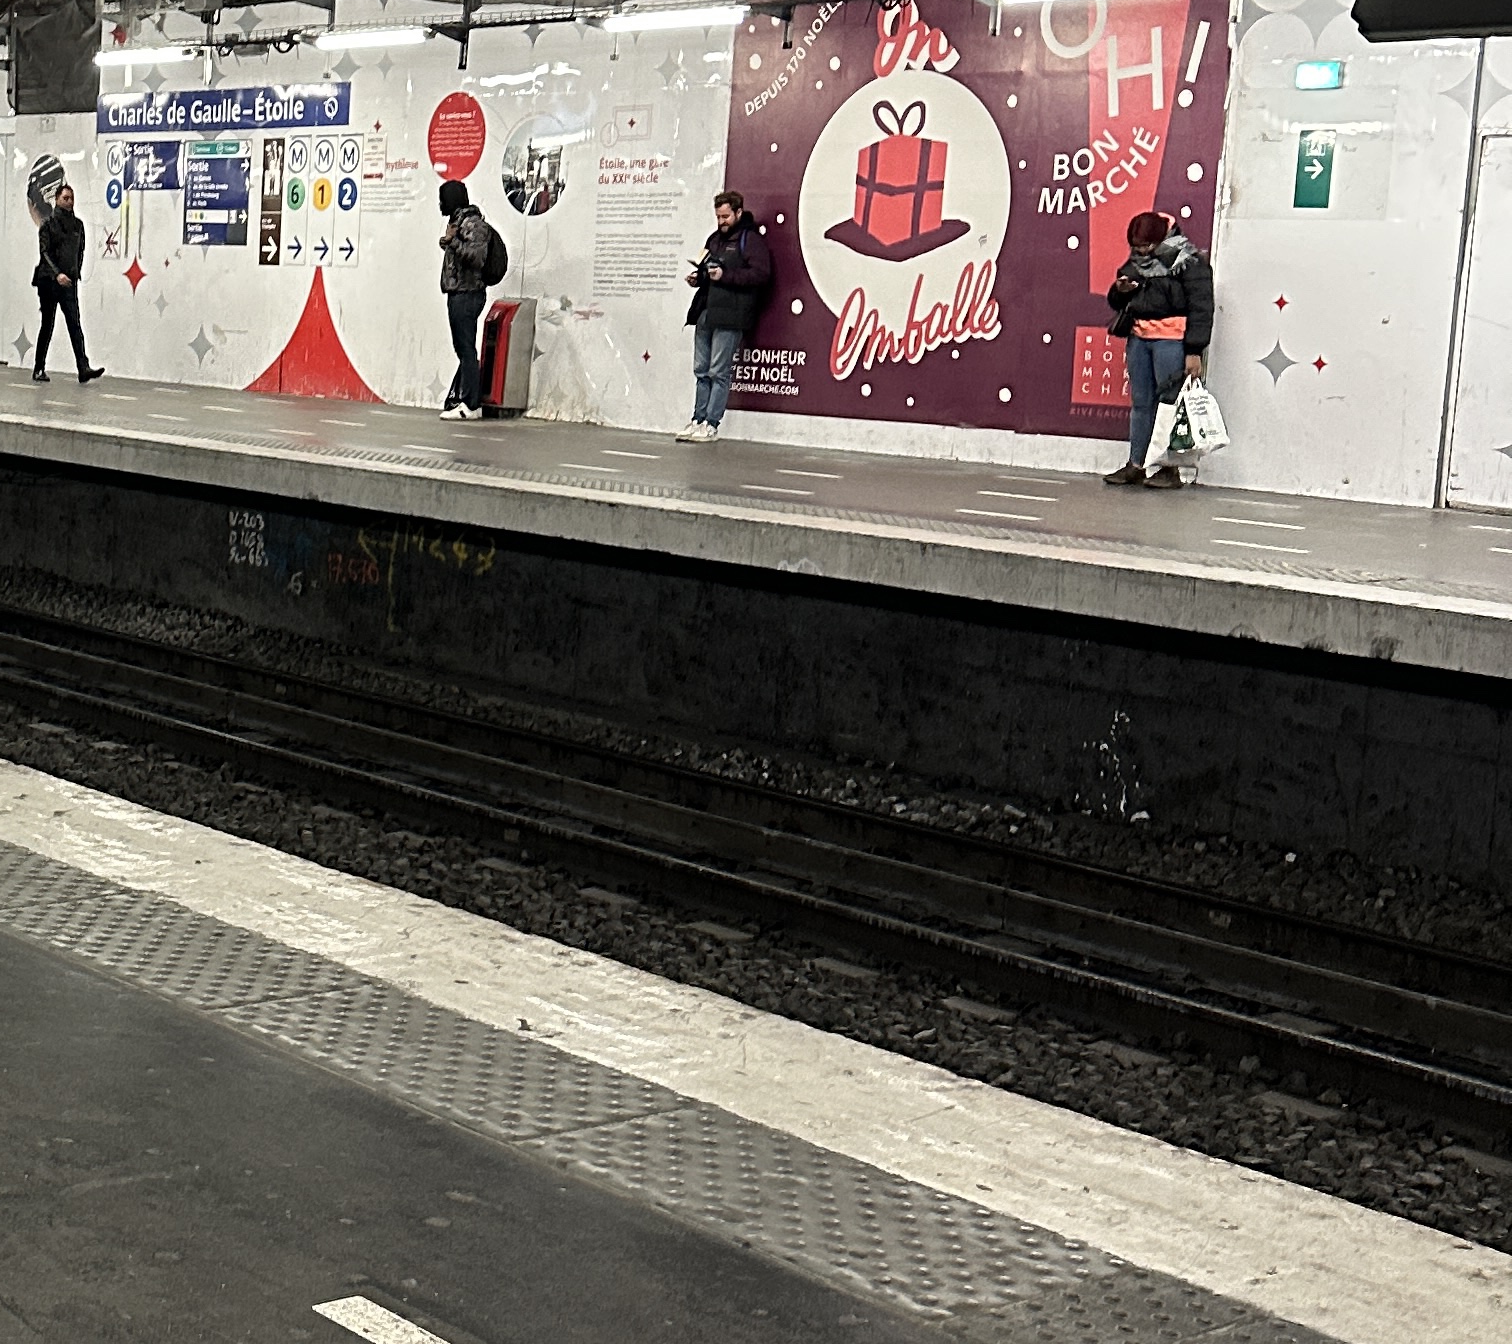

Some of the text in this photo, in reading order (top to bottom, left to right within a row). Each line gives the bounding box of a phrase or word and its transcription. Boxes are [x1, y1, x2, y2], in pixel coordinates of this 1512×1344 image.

[744, 73, 788, 116] DEPUIS
[786, 47, 806, 74] 170
[108, 102, 162, 127] Charles
[166, 102, 186, 125] de
[133, 143, 154, 156] Sortie
[1052, 128, 1120, 181] BON
[599, 157, 628, 170] Étoile,
[630, 159, 646, 169] une
[1037, 126, 1160, 214] MARCHÉ
[598, 173, 609, 184] du
[633, 172, 659, 184] siècle
[110, 184, 119, 205] 2
[341, 183, 353, 205] 2
[743, 348, 807, 366] BONHEUR
[1085, 350, 1127, 363] BO
[731, 364, 795, 383] 'EST NOËL
[1097, 408, 1129, 419] GAUC
